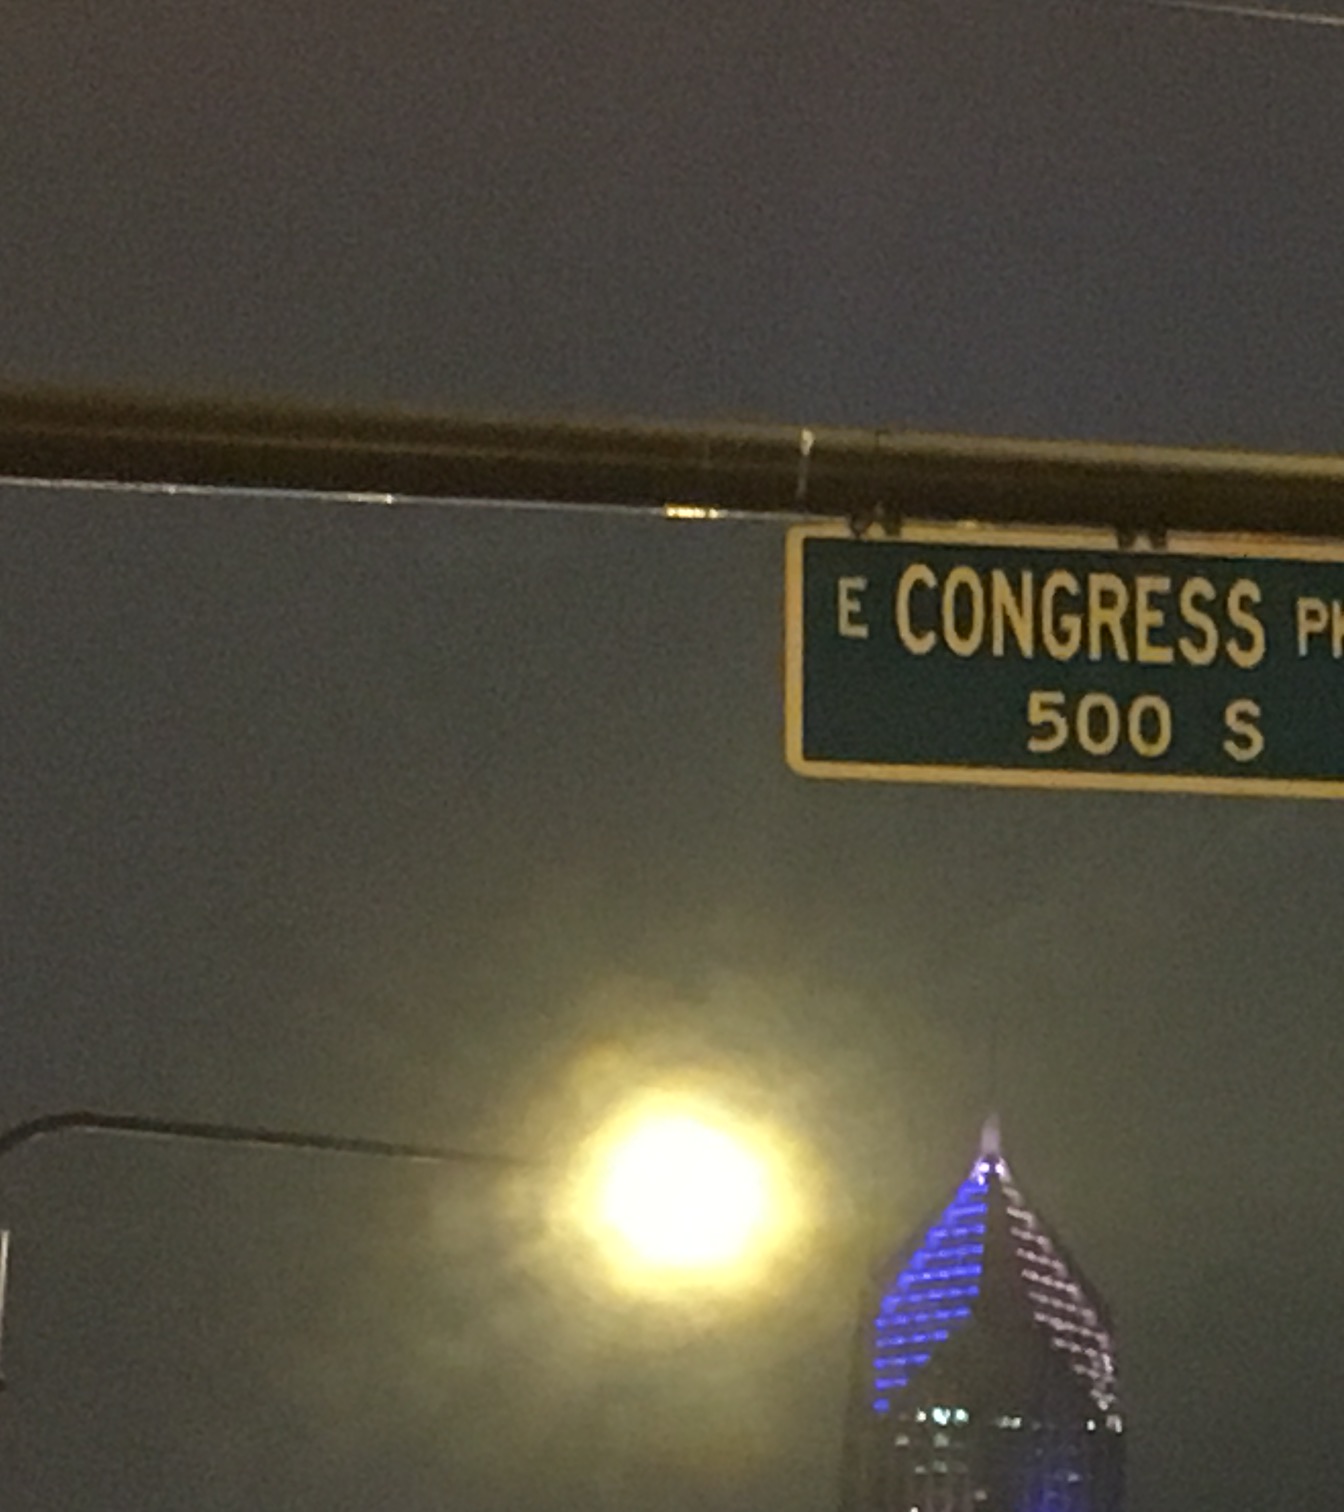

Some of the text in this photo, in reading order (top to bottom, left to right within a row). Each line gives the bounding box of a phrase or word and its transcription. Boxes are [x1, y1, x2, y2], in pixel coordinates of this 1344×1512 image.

[837, 576, 868, 638] E
[896, 564, 1267, 668] CONGRESS
[1027, 690, 1265, 762] 500 S
